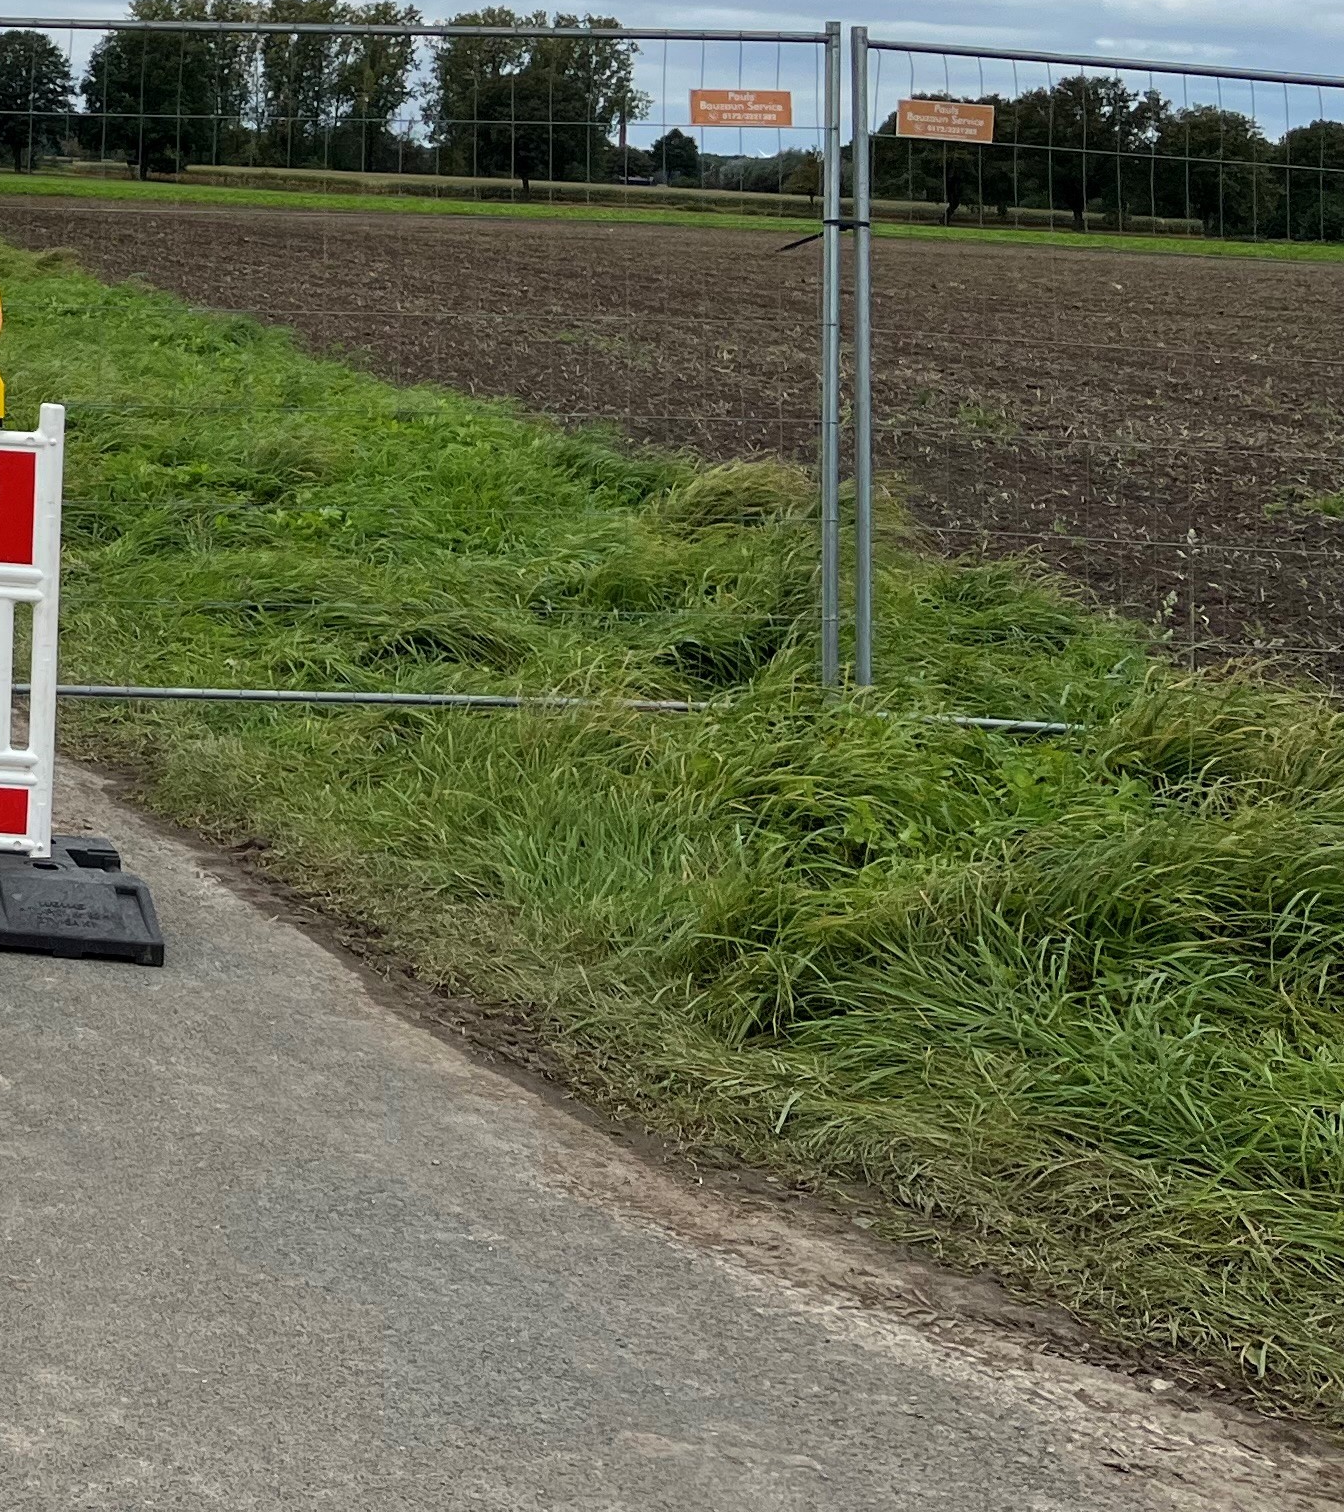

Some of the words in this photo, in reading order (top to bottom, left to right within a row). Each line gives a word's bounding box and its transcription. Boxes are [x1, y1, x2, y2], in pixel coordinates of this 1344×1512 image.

[728, 91, 755, 101] Pauls
[746, 101, 783, 111] Service
[952, 115, 985, 127] Service
